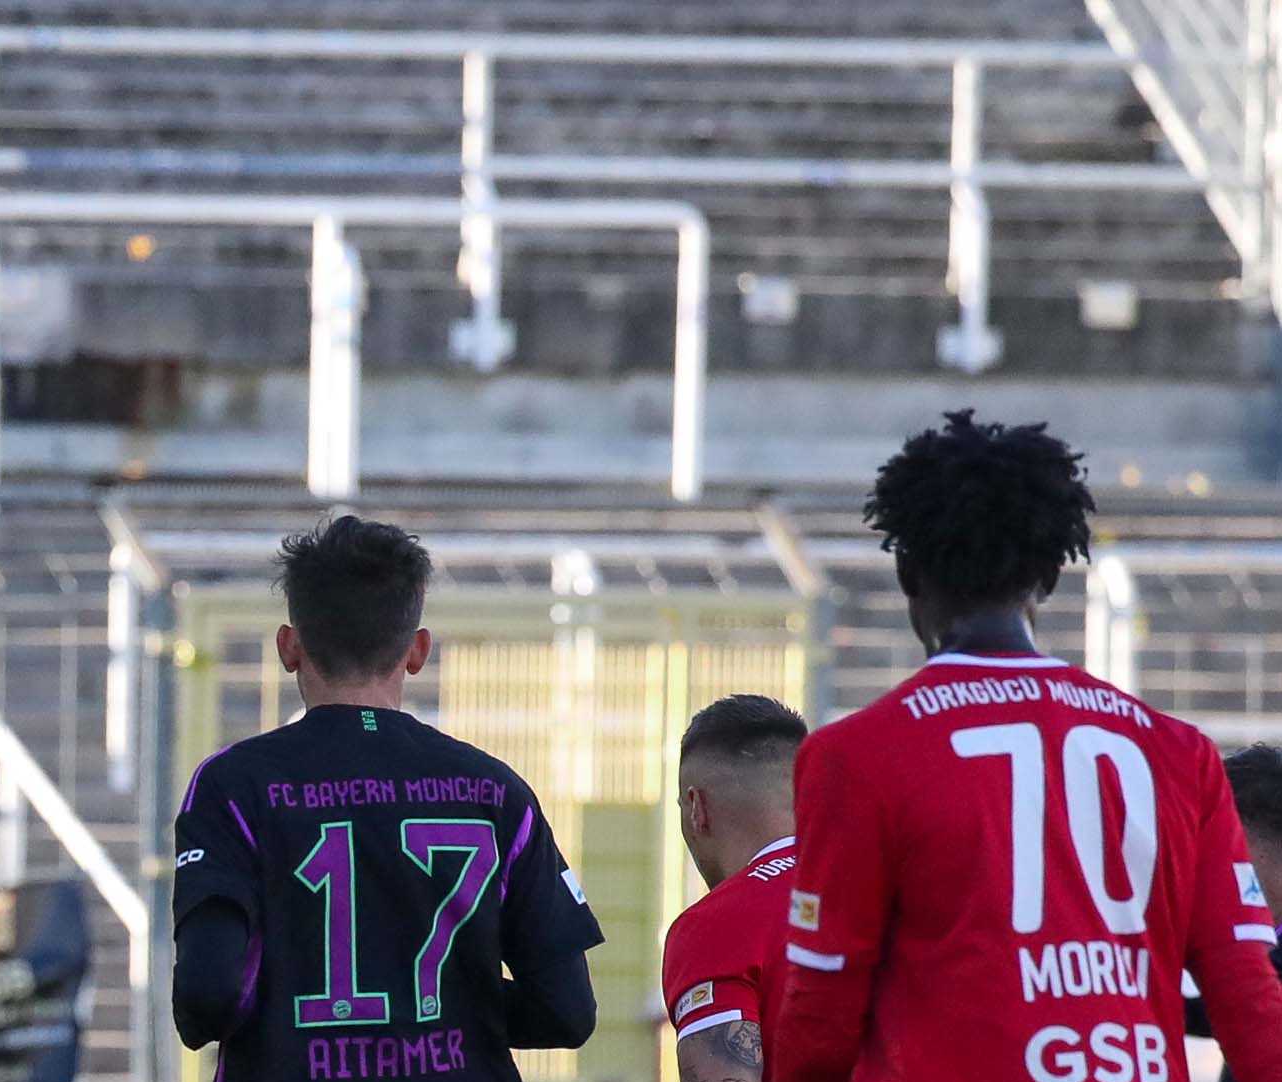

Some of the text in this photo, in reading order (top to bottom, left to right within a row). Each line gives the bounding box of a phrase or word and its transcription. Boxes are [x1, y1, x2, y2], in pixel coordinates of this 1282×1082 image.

[902, 676, 1041, 720] TÜRKGÜCÜ
[267, 776, 506, 808] FC BAYERN MÜNCHEN
[950, 722, 1158, 934] 70
[294, 818, 500, 1028] 17
[308, 1029, 465, 1081] AITAMER
